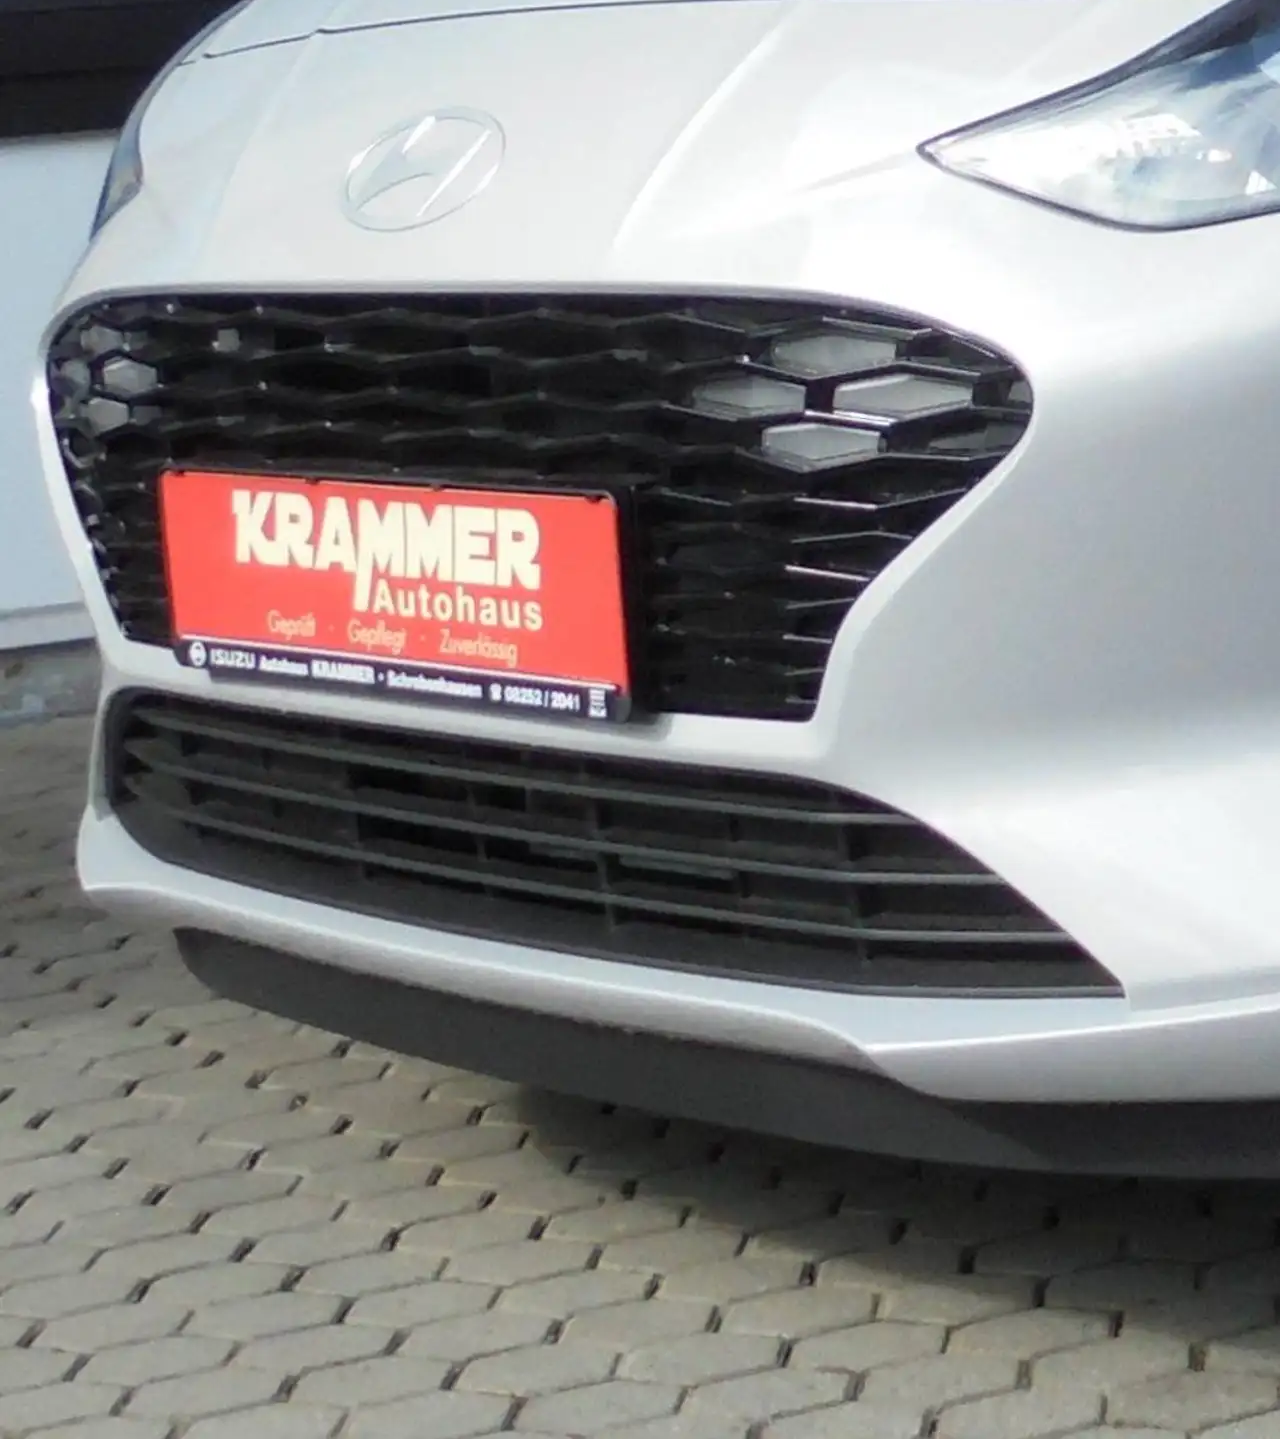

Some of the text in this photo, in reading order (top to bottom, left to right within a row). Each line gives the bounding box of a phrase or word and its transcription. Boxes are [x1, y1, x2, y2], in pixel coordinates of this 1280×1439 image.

[232, 489, 541, 612] KRAMMER
[374, 578, 543, 631] Autohaus
[210, 648, 256, 670] ISUZU
